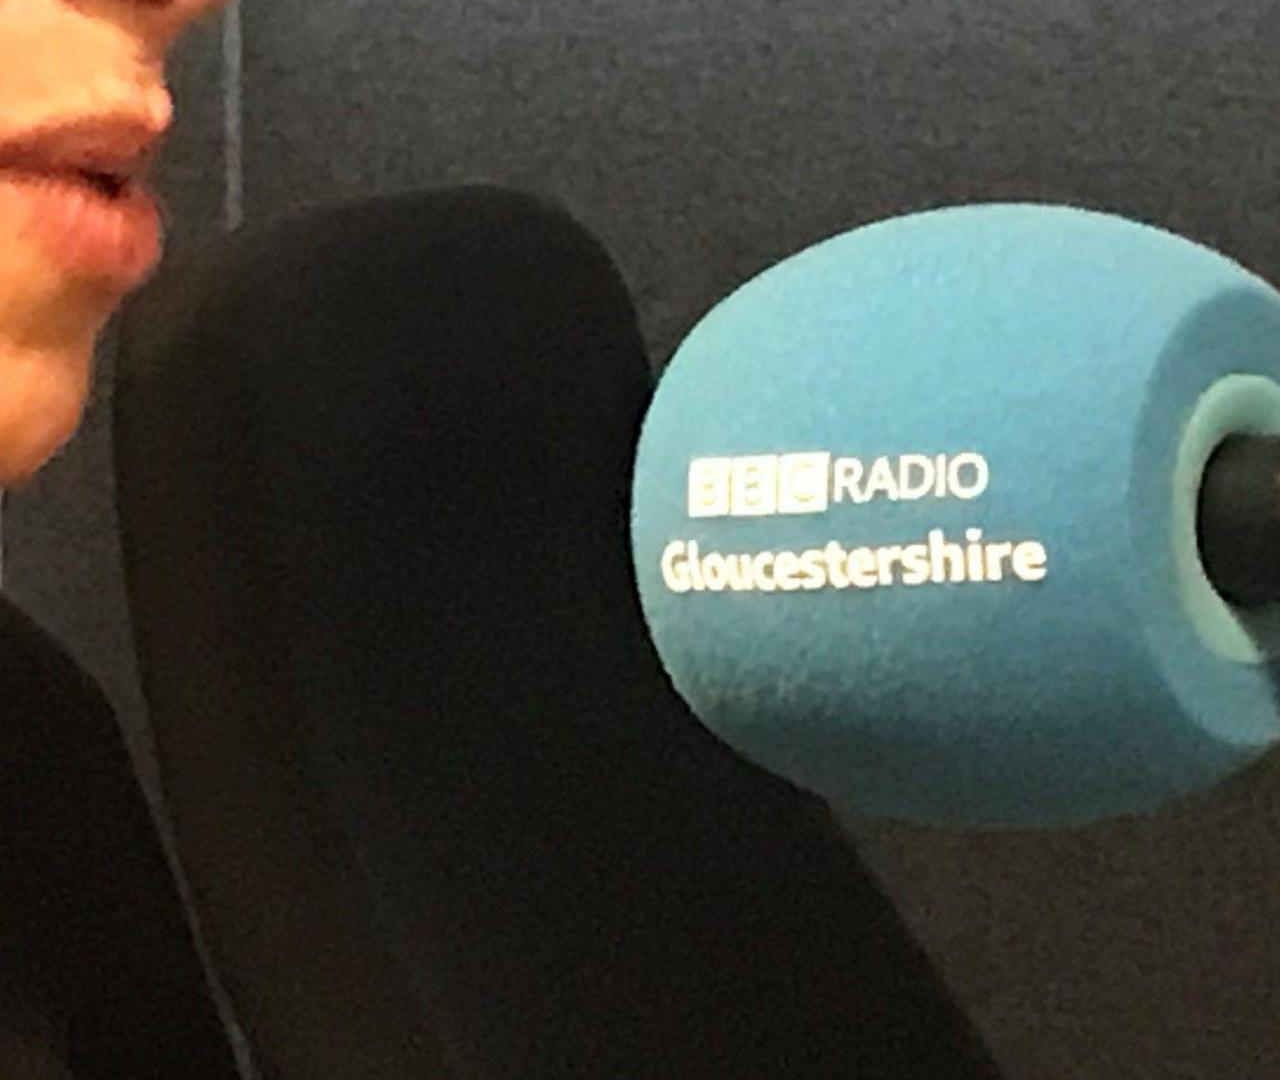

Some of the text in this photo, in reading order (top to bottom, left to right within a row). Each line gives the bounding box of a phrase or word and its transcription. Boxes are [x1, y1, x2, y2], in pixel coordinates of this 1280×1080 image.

[690, 451, 989, 515] BBC RADIO
[659, 527, 1048, 593] Gloucestershire
